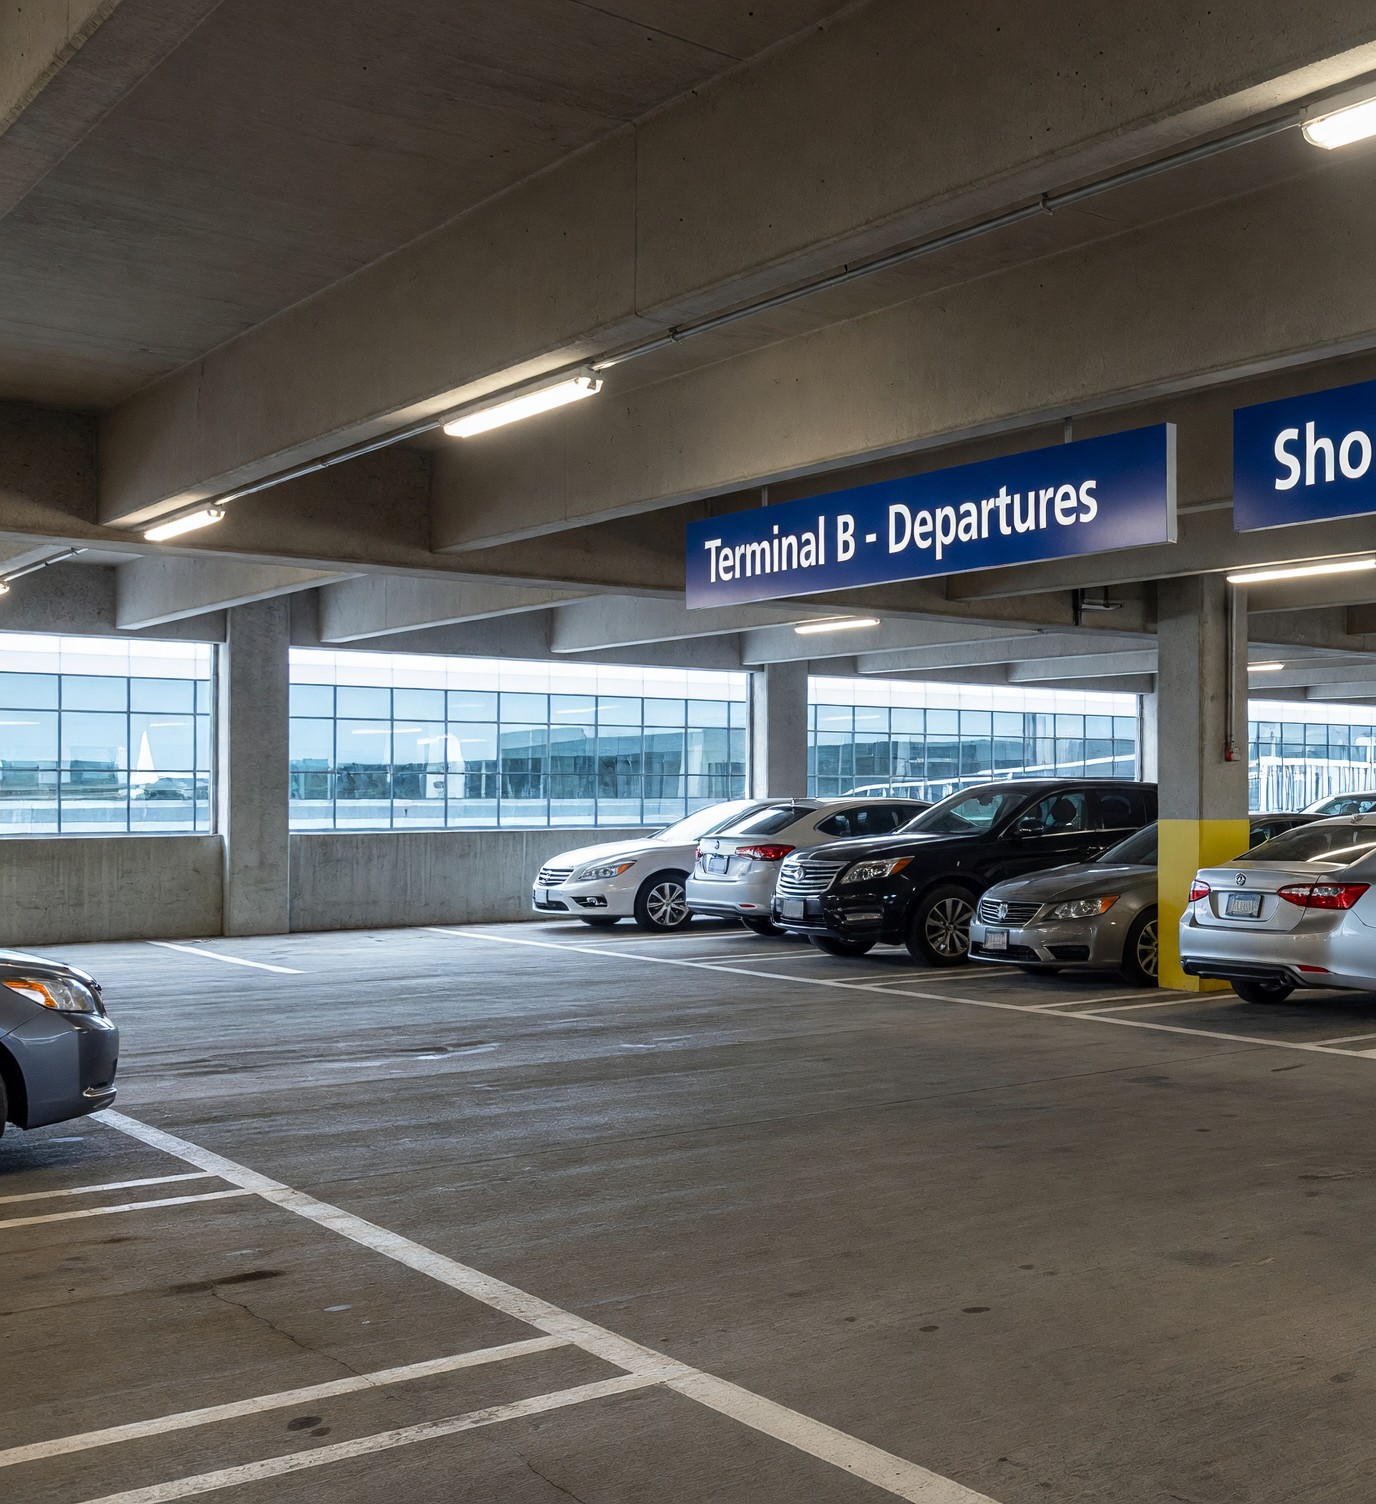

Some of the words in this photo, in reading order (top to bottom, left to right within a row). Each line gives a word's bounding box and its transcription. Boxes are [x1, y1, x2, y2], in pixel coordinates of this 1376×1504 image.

[704, 515, 825, 583] Terminal
[837, 514, 856, 562] B
[865, 533, 877, 543] -
[888, 480, 1098, 561] Departures
